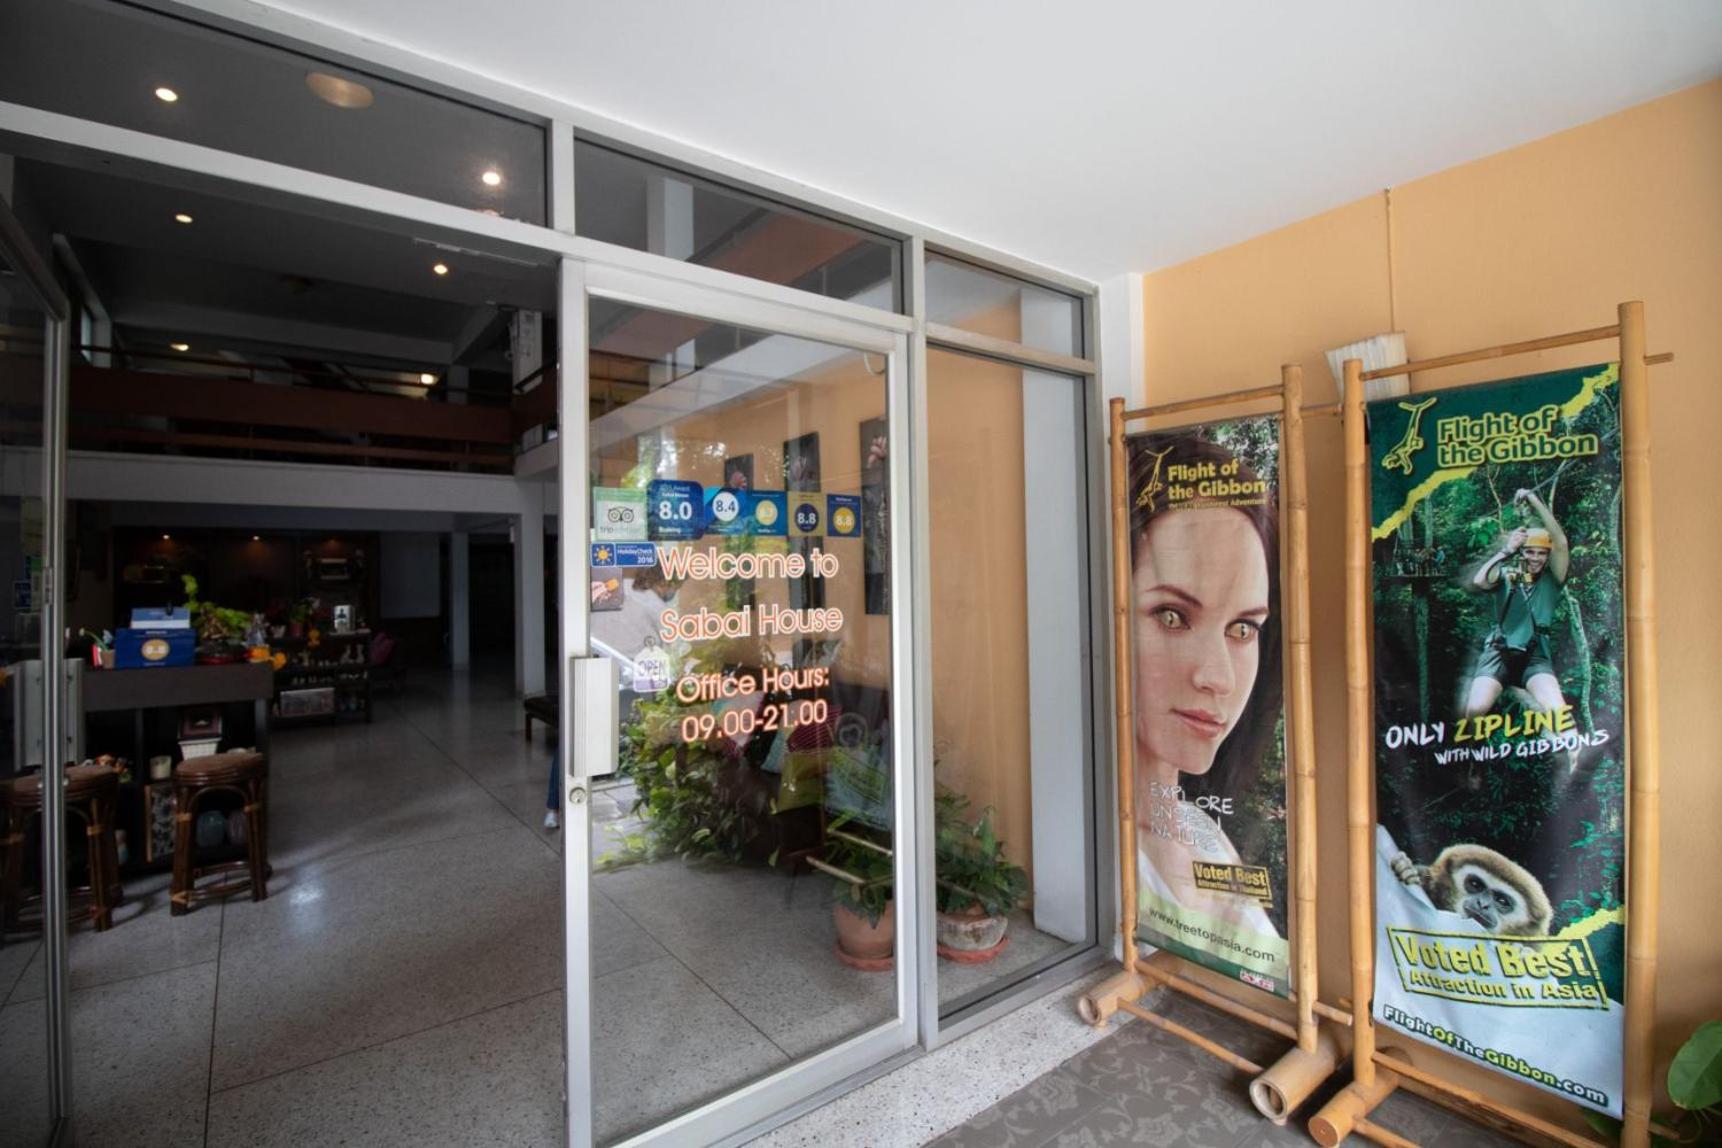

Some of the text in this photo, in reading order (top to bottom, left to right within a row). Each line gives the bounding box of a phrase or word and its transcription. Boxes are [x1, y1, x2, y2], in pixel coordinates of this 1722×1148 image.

[1438, 405, 1558, 443] Flight of
[1438, 434, 1598, 467] the Gibbon
[1168, 458, 1240, 482] Flight of
[715, 499, 735, 513] 8.4
[1168, 479, 1266, 499] the Gibbon
[659, 500, 692, 520] 8.0
[797, 512, 816, 525] 8.8
[657, 546, 839, 580] Welcome to
[660, 604, 843, 643] Sabai House
[676, 666, 829, 702] Office Hours:
[682, 702, 828, 742] 09.00-21.00
[1385, 704, 1576, 749] ONLY ZIPLINE
[1434, 729, 1610, 765] WITH WILD GIBBONS
[1194, 864, 1266, 886] Voted Best
[1149, 908, 1275, 962] www.treetopasia.com
[1396, 935, 1591, 979] Voted Best
[1410, 969, 1598, 1000] Attraction in Asia
[1383, 1004, 1609, 1107] FlightOfTheGibbon.com
